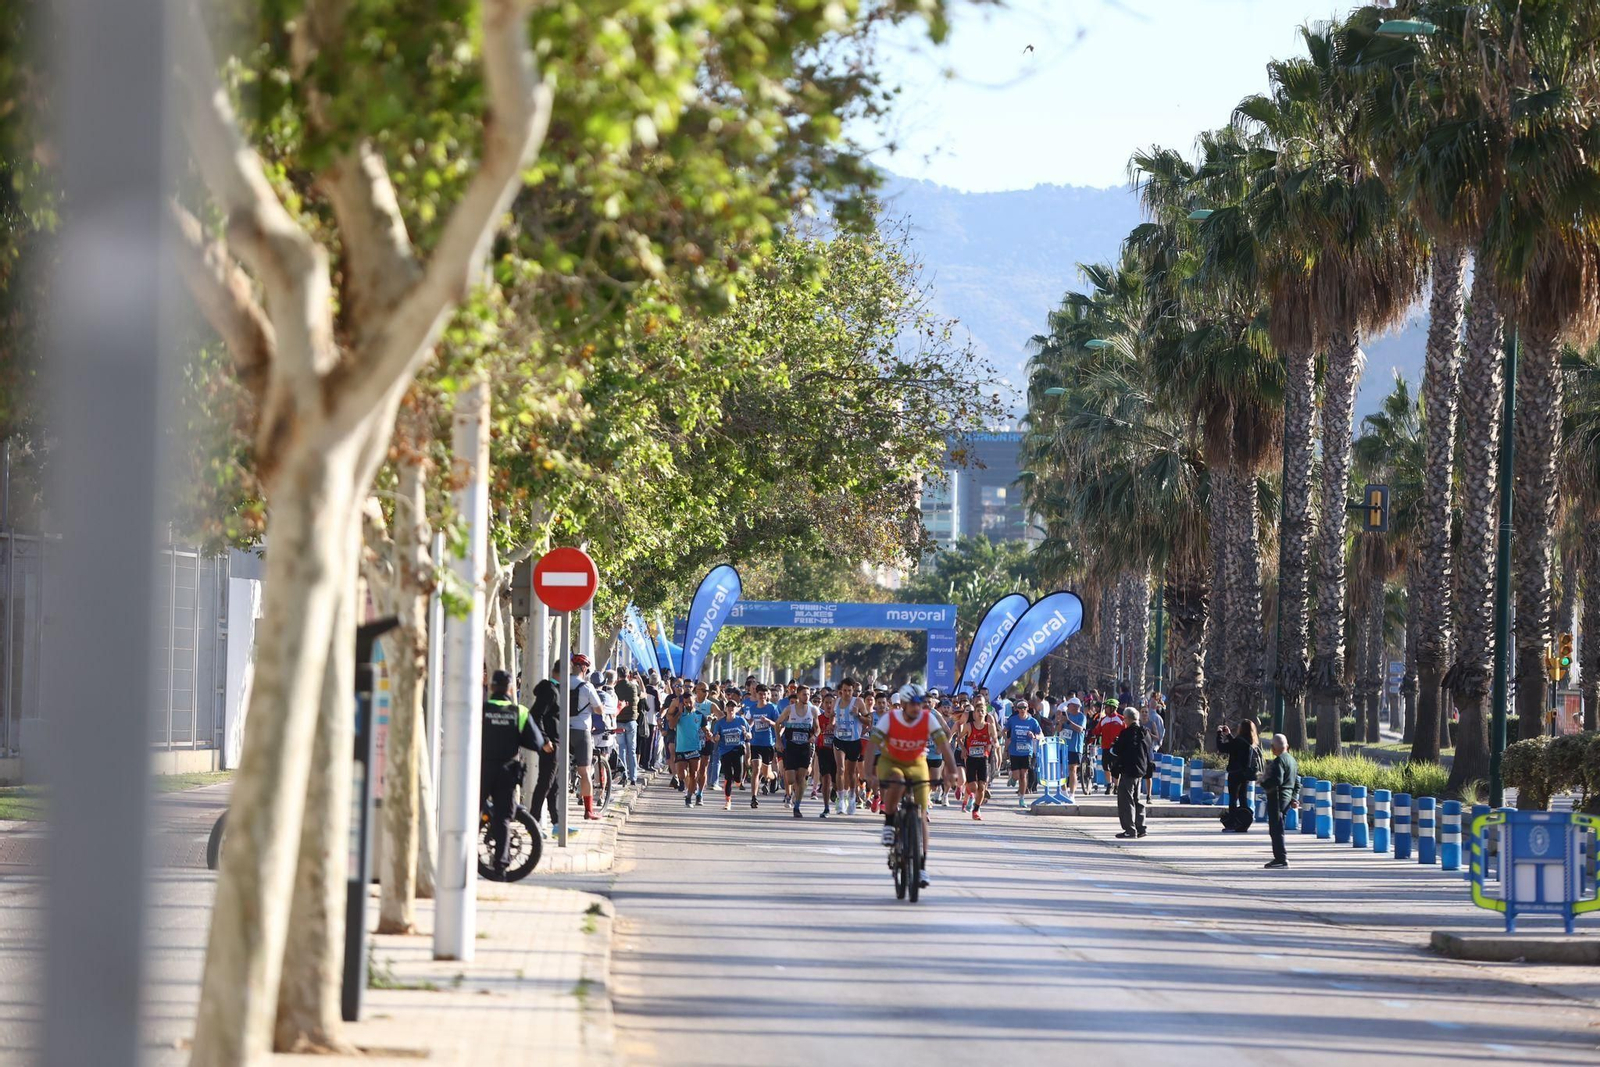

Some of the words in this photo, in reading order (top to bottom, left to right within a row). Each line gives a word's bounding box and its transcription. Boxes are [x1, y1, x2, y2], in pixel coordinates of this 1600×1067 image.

[689, 584, 729, 656] mayoral
[886, 609, 945, 623] mayoral
[970, 612, 1017, 679] mayoral
[1000, 610, 1067, 674] mayoral
[889, 737, 925, 747] STOP
